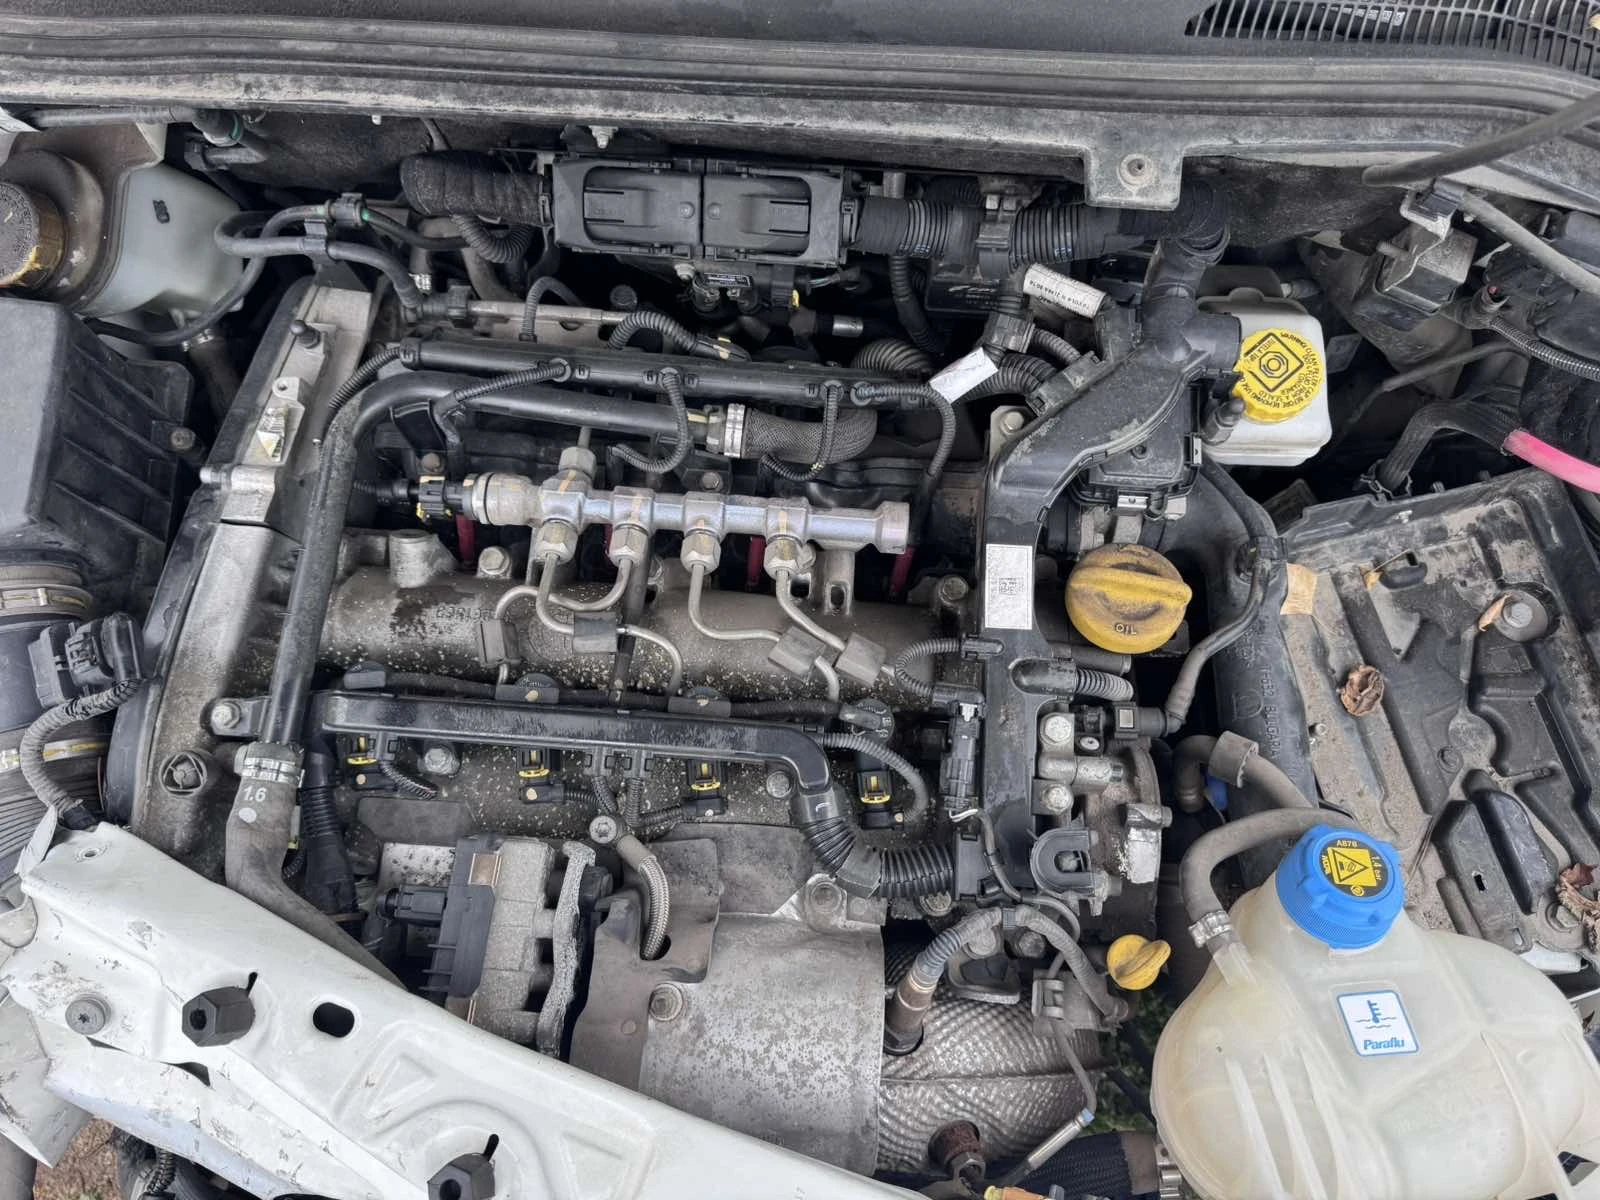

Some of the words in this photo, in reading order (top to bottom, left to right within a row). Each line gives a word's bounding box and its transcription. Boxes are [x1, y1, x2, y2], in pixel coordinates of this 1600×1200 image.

[1114, 621, 1137, 636] OIL
[243, 785, 267, 803] 1.6
[1363, 1036, 1405, 1050] Paraflu
